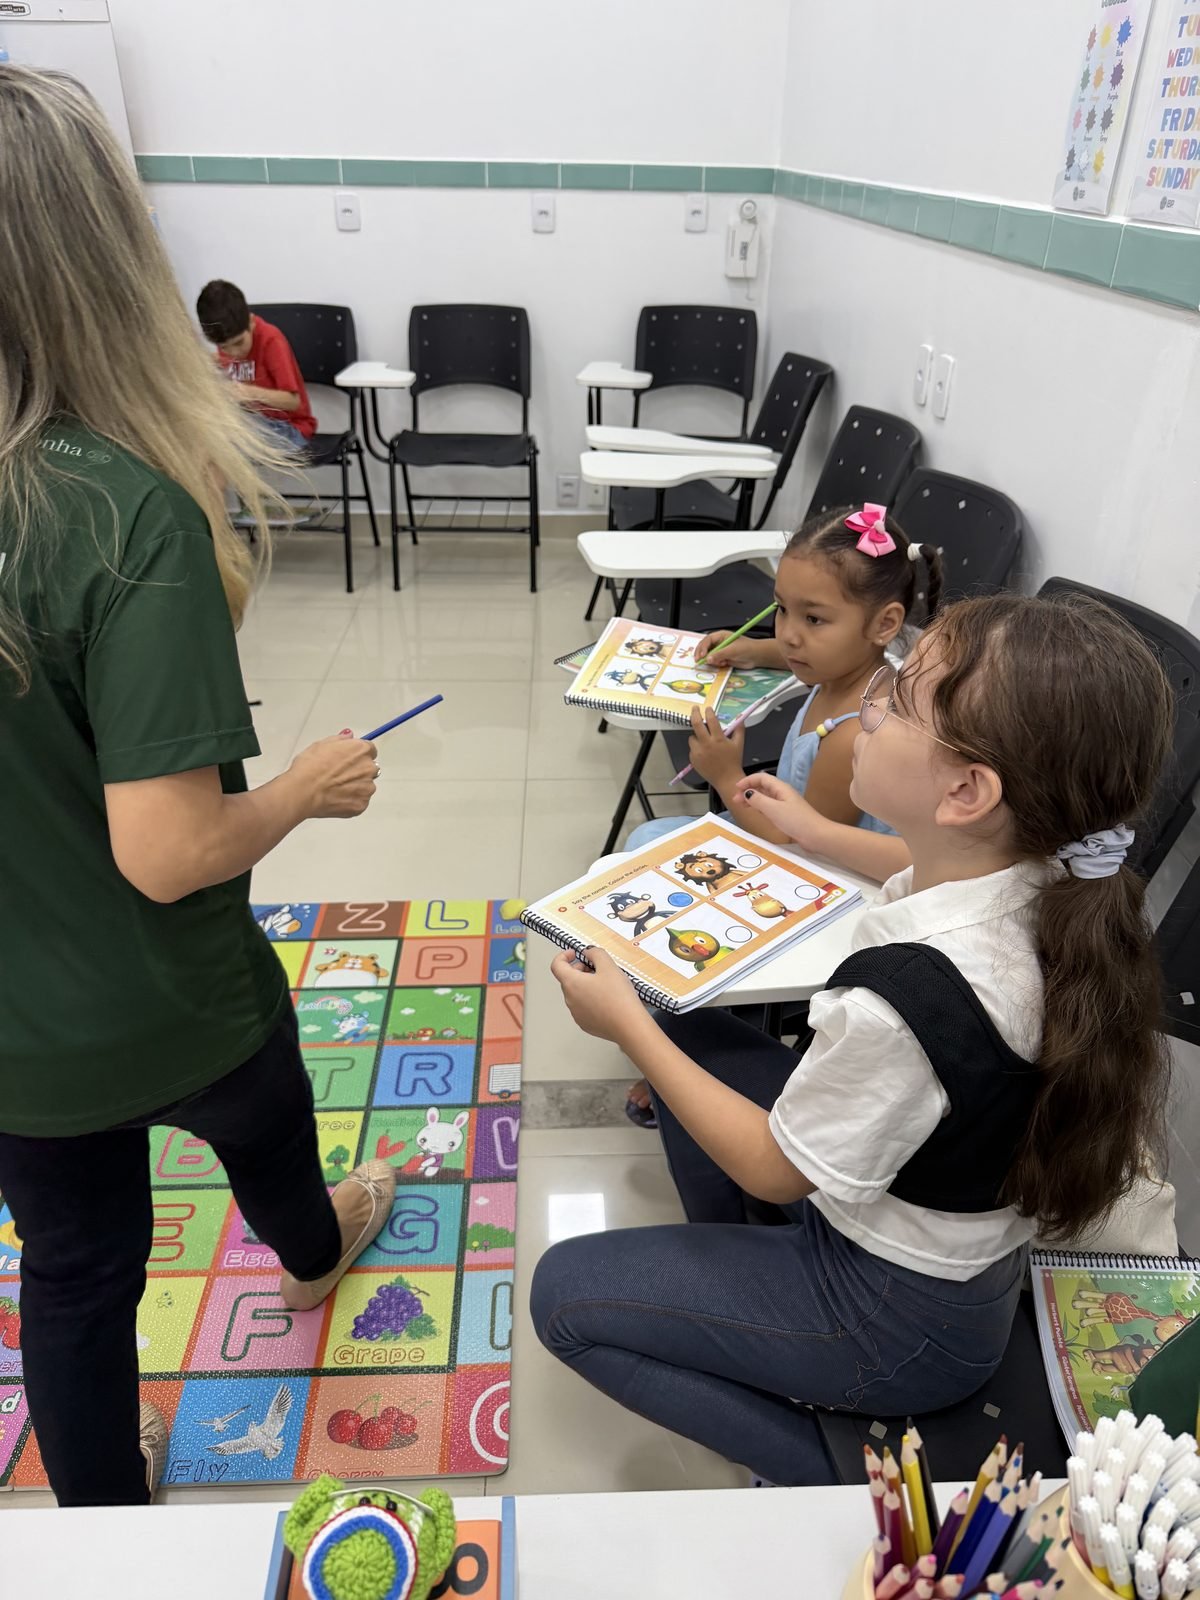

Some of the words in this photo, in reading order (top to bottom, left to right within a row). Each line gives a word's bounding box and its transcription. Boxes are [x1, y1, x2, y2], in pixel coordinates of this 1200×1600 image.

[1146, 166, 1200, 190] SUNDAY
[40, 438, 82, 457] nha
[337, 901, 389, 932] Z
[425, 900, 469, 930] L
[415, 945, 468, 980] P
[493, 969, 527, 982] Pe
[395, 1052, 454, 1097] R
[318, 1118, 356, 1131] ree
[372, 1194, 440, 1254] G
[220, 1291, 293, 1361] F
[333, 1345, 425, 1366] Grape
[167, 1458, 229, 1484] Fly
